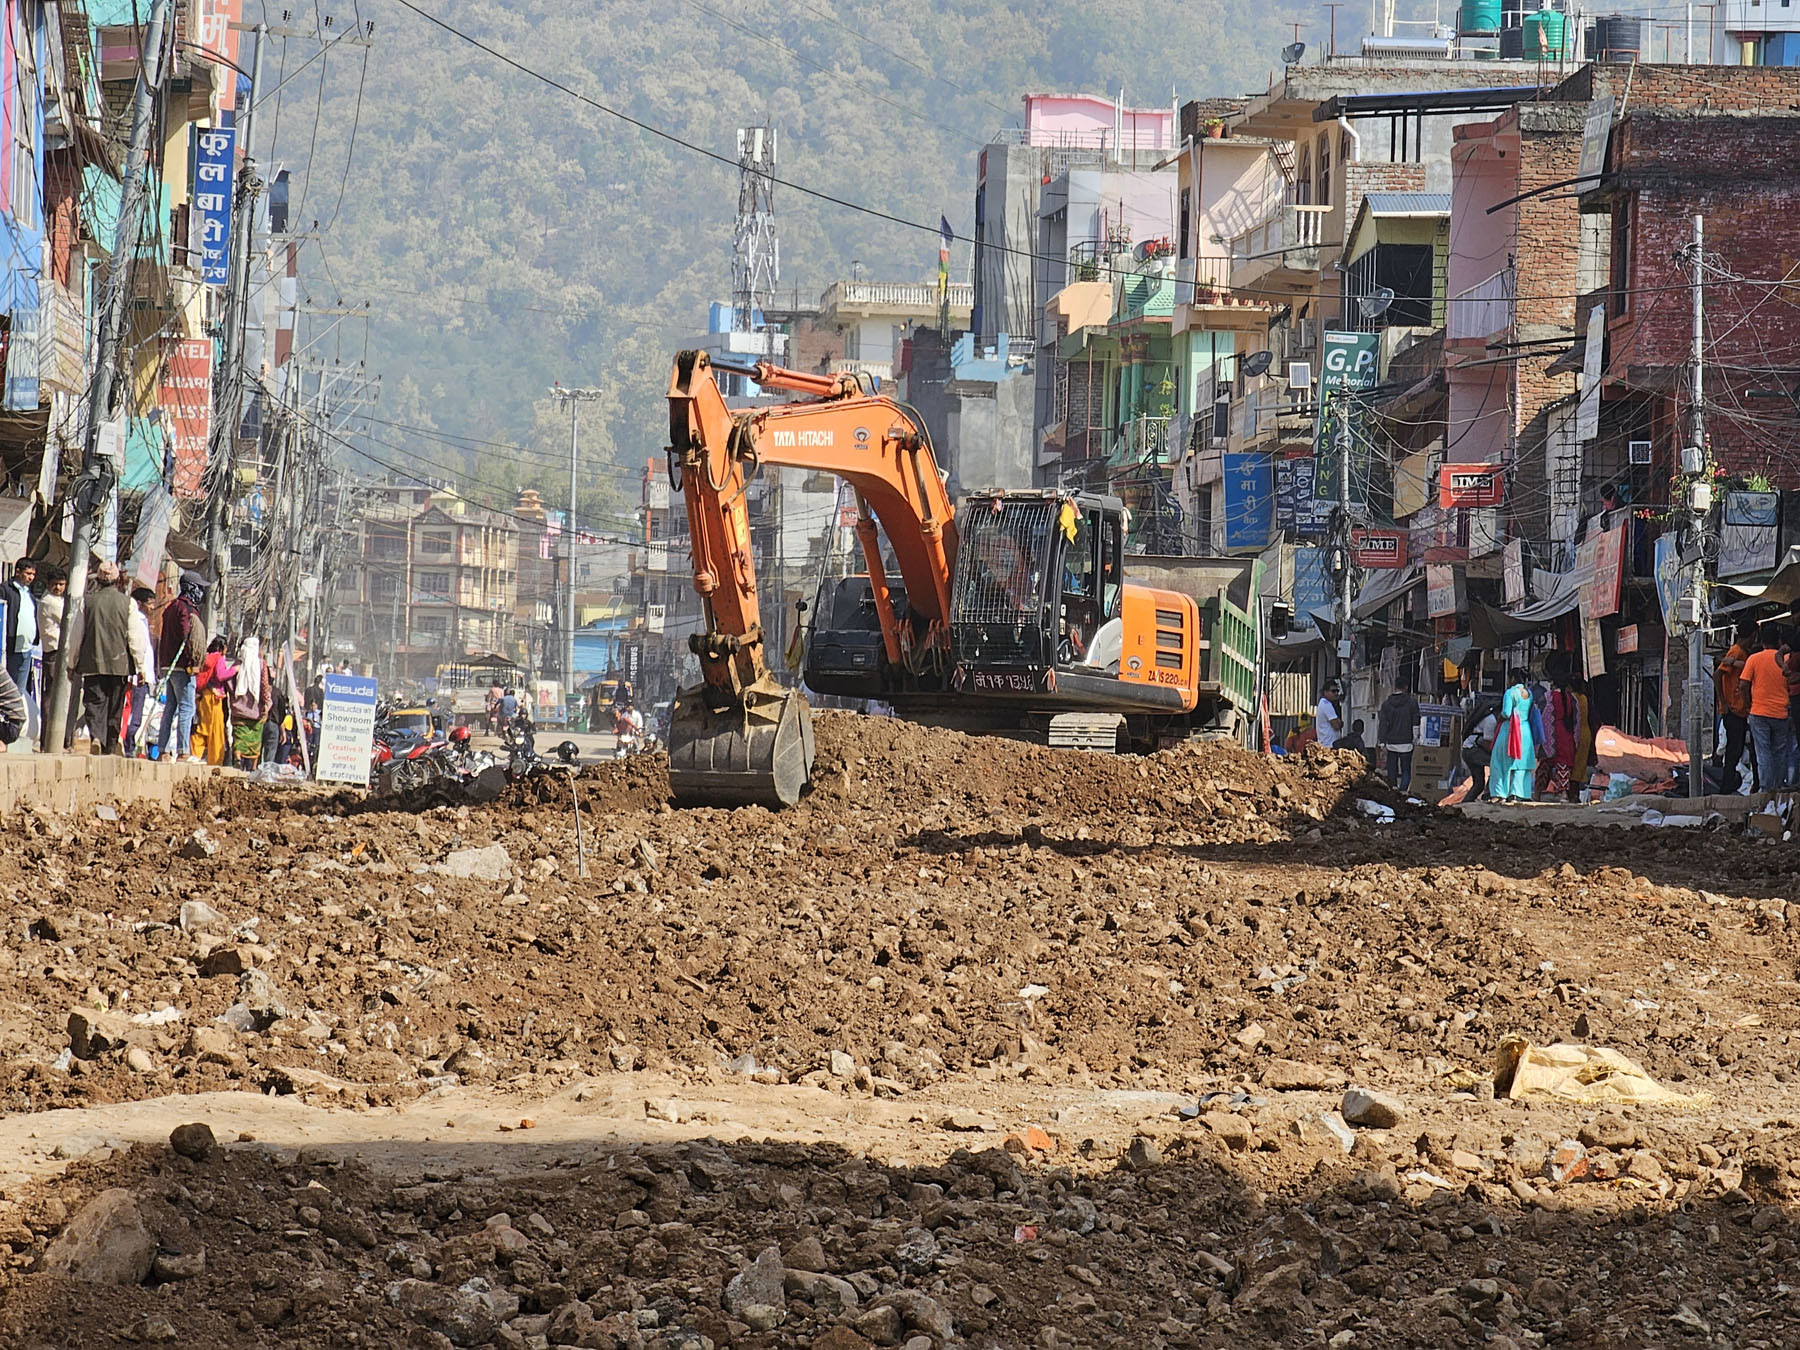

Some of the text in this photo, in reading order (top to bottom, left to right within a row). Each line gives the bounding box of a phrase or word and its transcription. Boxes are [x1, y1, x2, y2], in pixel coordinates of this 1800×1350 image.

[1325, 348, 1375, 373] G.P.
[774, 430, 834, 447] TATA HITACHI
[1458, 476, 1490, 487] IME
[327, 682, 374, 697] Yasuda
[326, 703, 362, 714] Yasuda
[327, 712, 372, 725] Showroom
